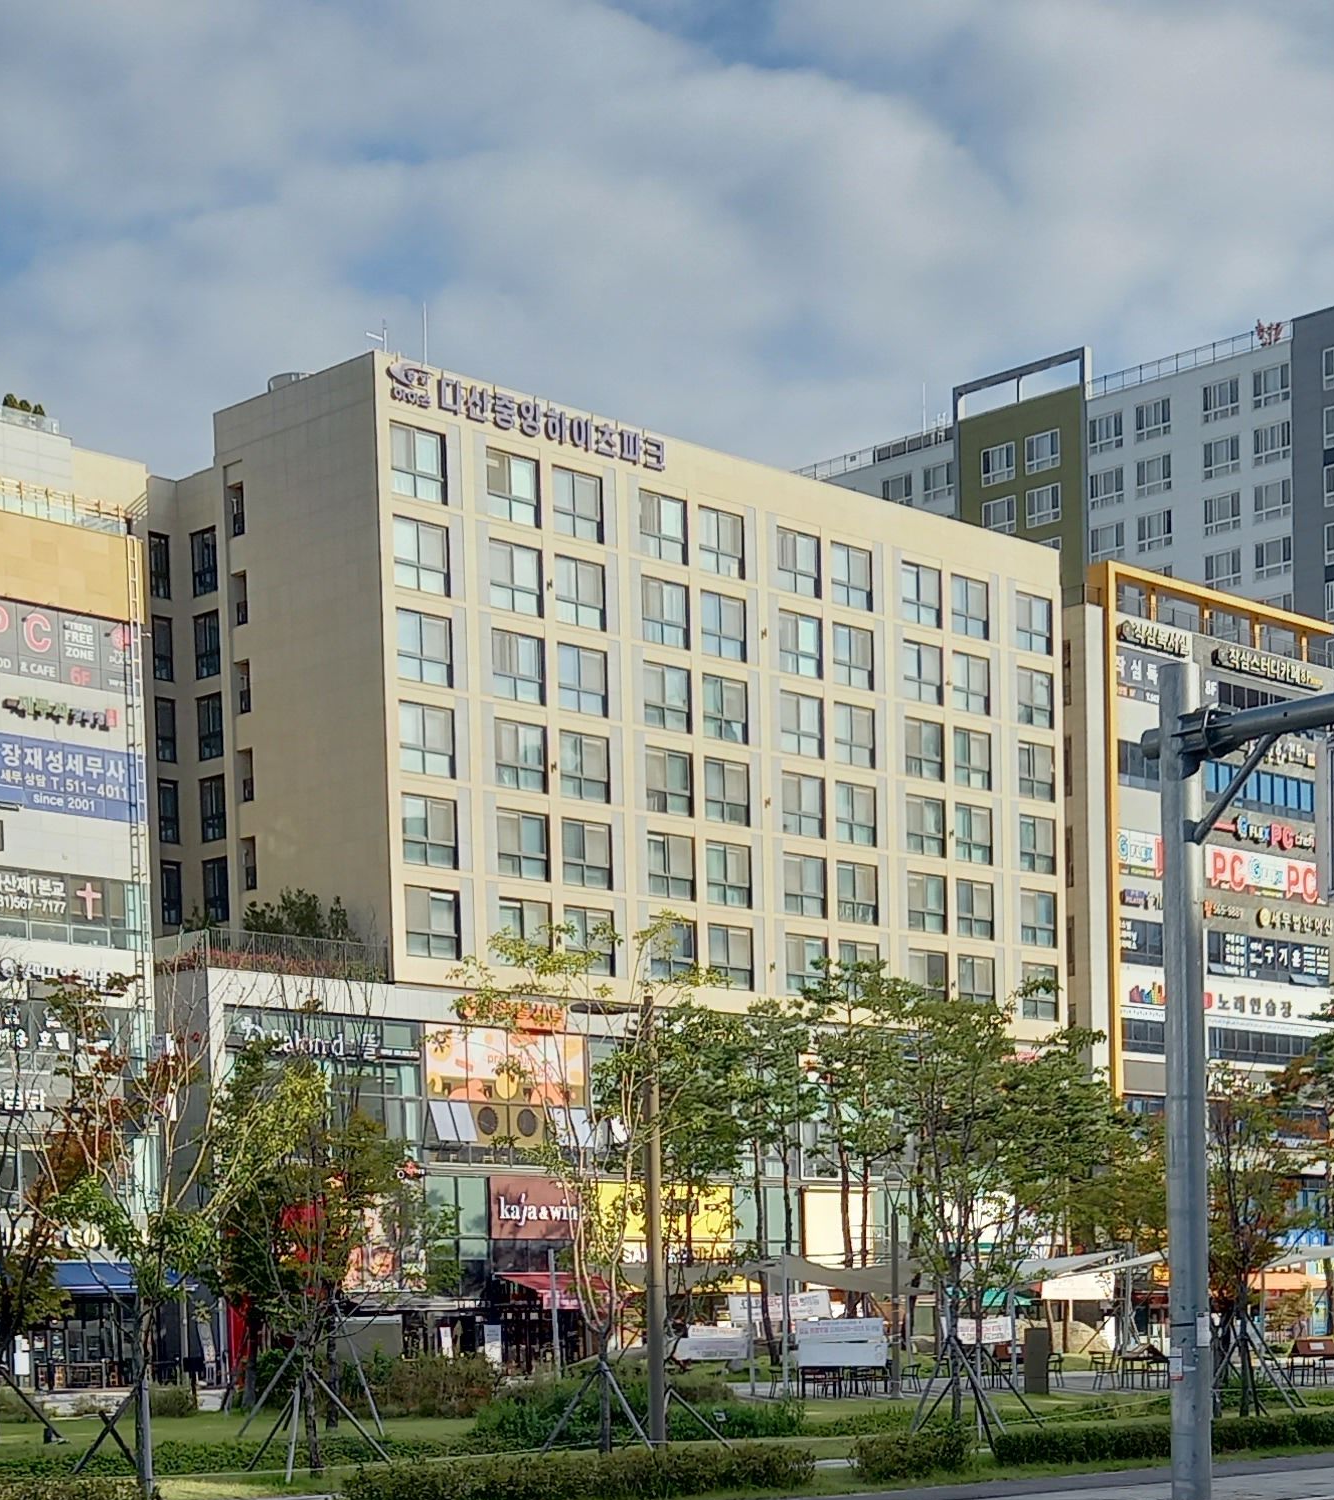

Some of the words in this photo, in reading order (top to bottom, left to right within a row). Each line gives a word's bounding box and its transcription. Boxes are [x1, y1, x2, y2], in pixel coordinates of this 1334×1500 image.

[439, 377, 665, 473] 다산중앙하이츠파크
[64, 630, 94, 646] FREE
[65, 647, 95, 661] ZONE
[30, 663, 56, 678] CAFE
[69, 665, 92, 686] 6F
[0, 743, 125, 783] 장재성세무사
[0, 769, 22, 783] 세무
[24, 771, 46, 787] 상담
[33, 792, 65, 807] since
[68, 796, 95, 812] 2001
[1270, 822, 1293, 849] PC
[1212, 849, 1245, 891] PC
[1285, 863, 1318, 904] PC
